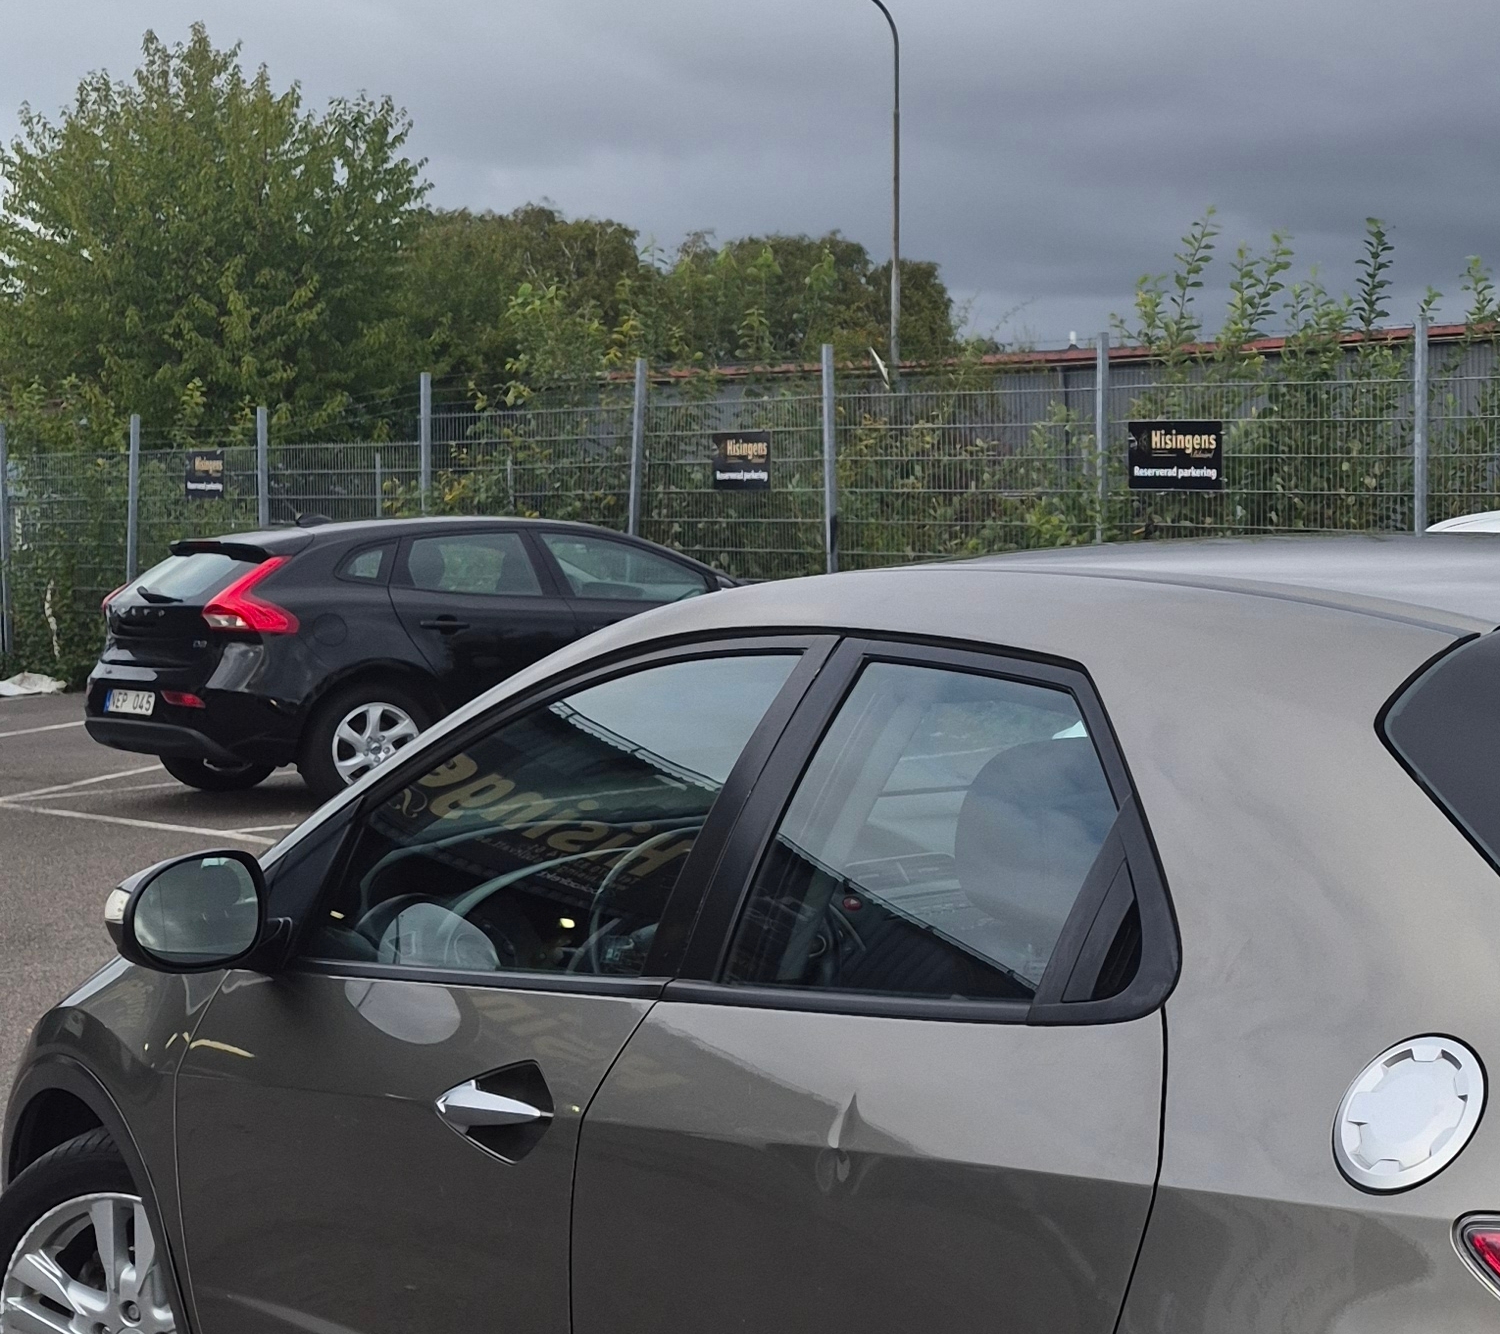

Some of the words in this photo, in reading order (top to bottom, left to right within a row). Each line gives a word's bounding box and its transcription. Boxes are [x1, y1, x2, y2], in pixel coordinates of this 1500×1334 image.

[727, 438, 768, 460] Hisingens
[1151, 429, 1217, 454] Hisingens
[1133, 466, 1177, 477] Reserverad
[1177, 466, 1217, 480] parkering
[111, 692, 128, 709] NEP
[132, 692, 153, 712] 045
